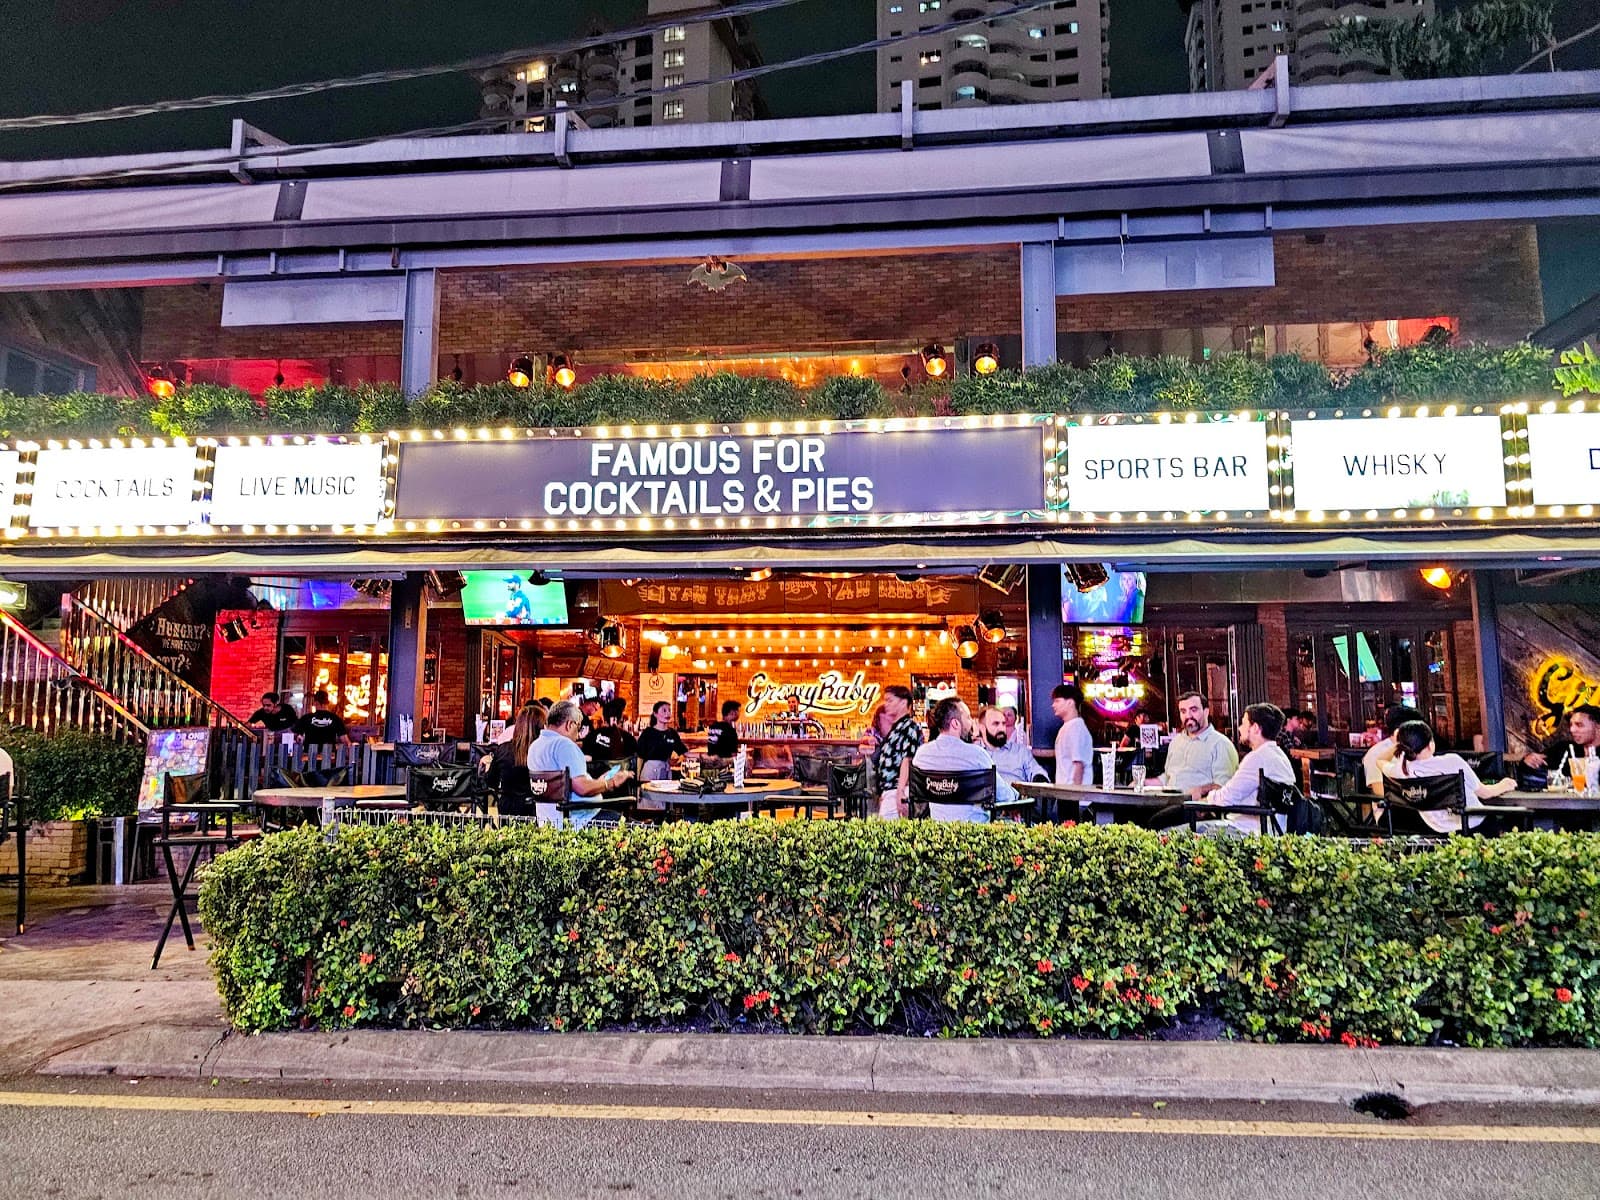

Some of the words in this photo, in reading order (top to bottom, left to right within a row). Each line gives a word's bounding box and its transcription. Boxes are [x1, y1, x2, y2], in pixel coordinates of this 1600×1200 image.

[591, 440, 741, 477] FAMOUS
[753, 438, 826, 473] FOR
[1084, 457, 1184, 480] SPORTS
[1194, 455, 1247, 478] BAR
[1343, 453, 1446, 476] WHISKY
[55, 477, 174, 498] COCKTAILS
[240, 476, 288, 496] LIVE
[294, 476, 355, 495] MUSIC
[544, 479, 745, 516] COCKTAILS
[754, 474, 782, 513] &
[792, 476, 874, 512] PIES
